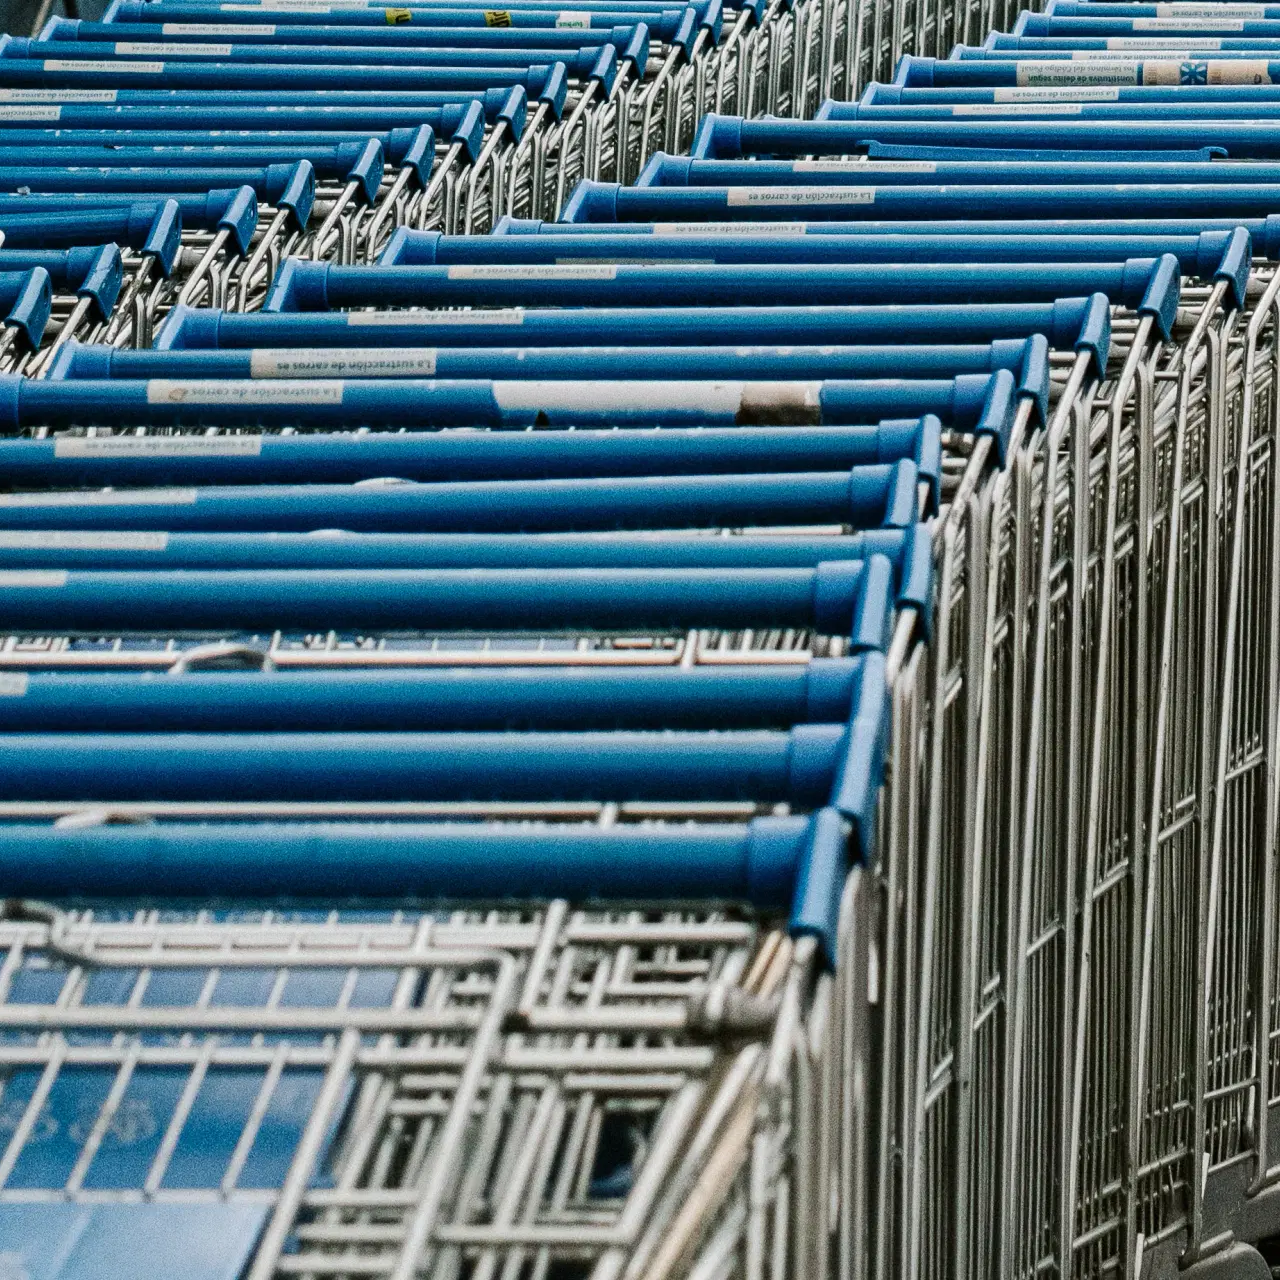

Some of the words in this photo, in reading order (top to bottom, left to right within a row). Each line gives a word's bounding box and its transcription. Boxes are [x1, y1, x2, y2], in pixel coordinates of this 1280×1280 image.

[1073, 66, 1086, 74] del
[1077, 75, 1086, 84] de
[791, 193, 804, 201] de
[806, 192, 858, 201] sustracción
[860, 192, 871, 200] La
[292, 362, 329, 370] carros
[331, 362, 346, 371] de
[349, 361, 415, 371] sustracción
[418, 360, 431, 370] La
[233, 388, 249, 397] de
[324, 388, 337, 398] La
